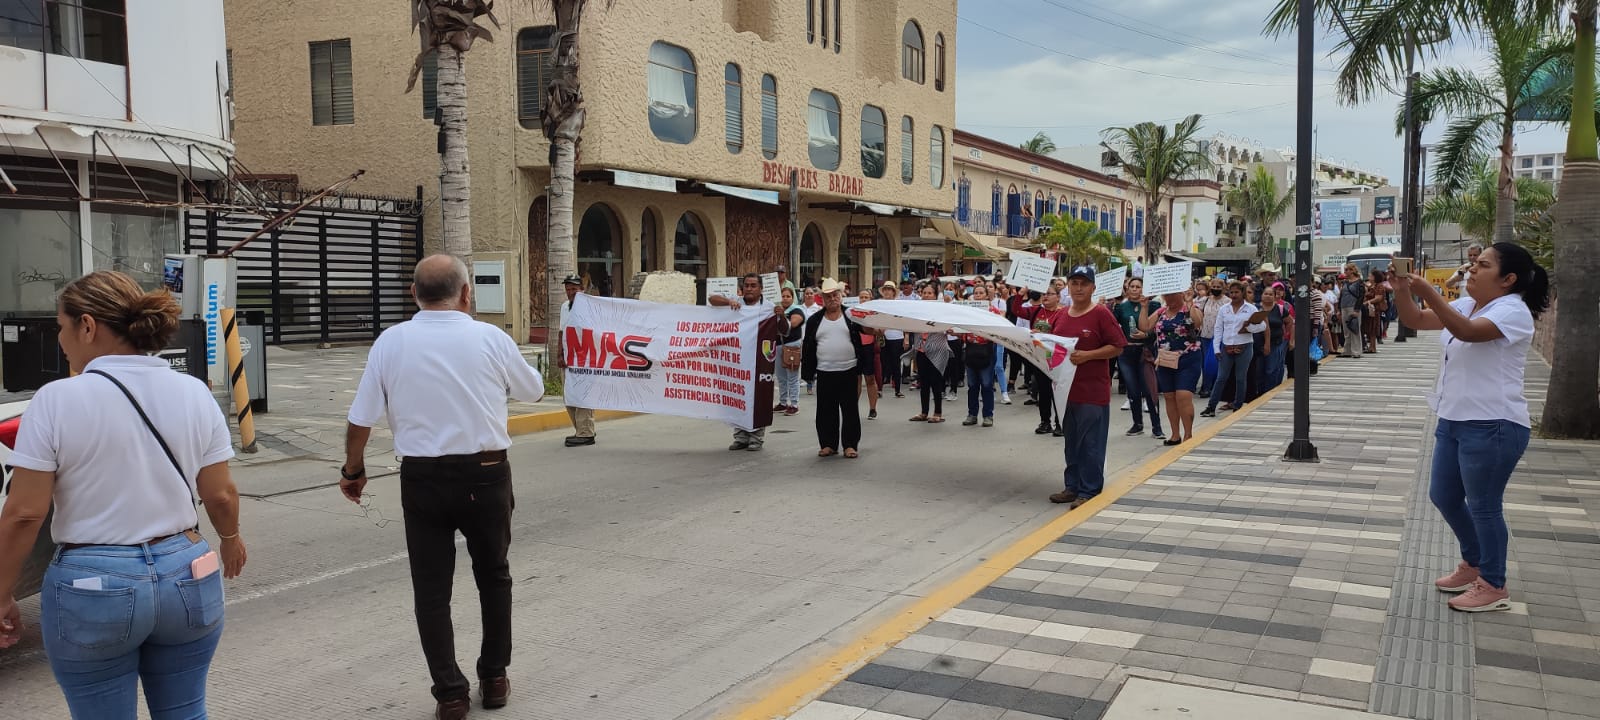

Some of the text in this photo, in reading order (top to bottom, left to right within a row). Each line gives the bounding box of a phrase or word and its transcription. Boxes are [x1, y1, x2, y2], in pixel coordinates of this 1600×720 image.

[828, 173, 864, 197] BAZAAR
[206, 284, 218, 365] infinitum
[677, 321, 740, 333] LOS DESPLAZADOS
[565, 326, 653, 371] MAS
[669, 335, 682, 347] DEL
[684, 336, 698, 348] SUR
[698, 337, 709, 348] DE
[667, 350, 741, 364] SEGUIMOS EN PIE DE
[661, 361, 751, 381] LUCHA POR UNA VIVIENDA
[665, 372, 746, 396] Y SERVICIOS PÚBLICOS
[664, 387, 746, 411] ASISTENCIALES DIGNOS
